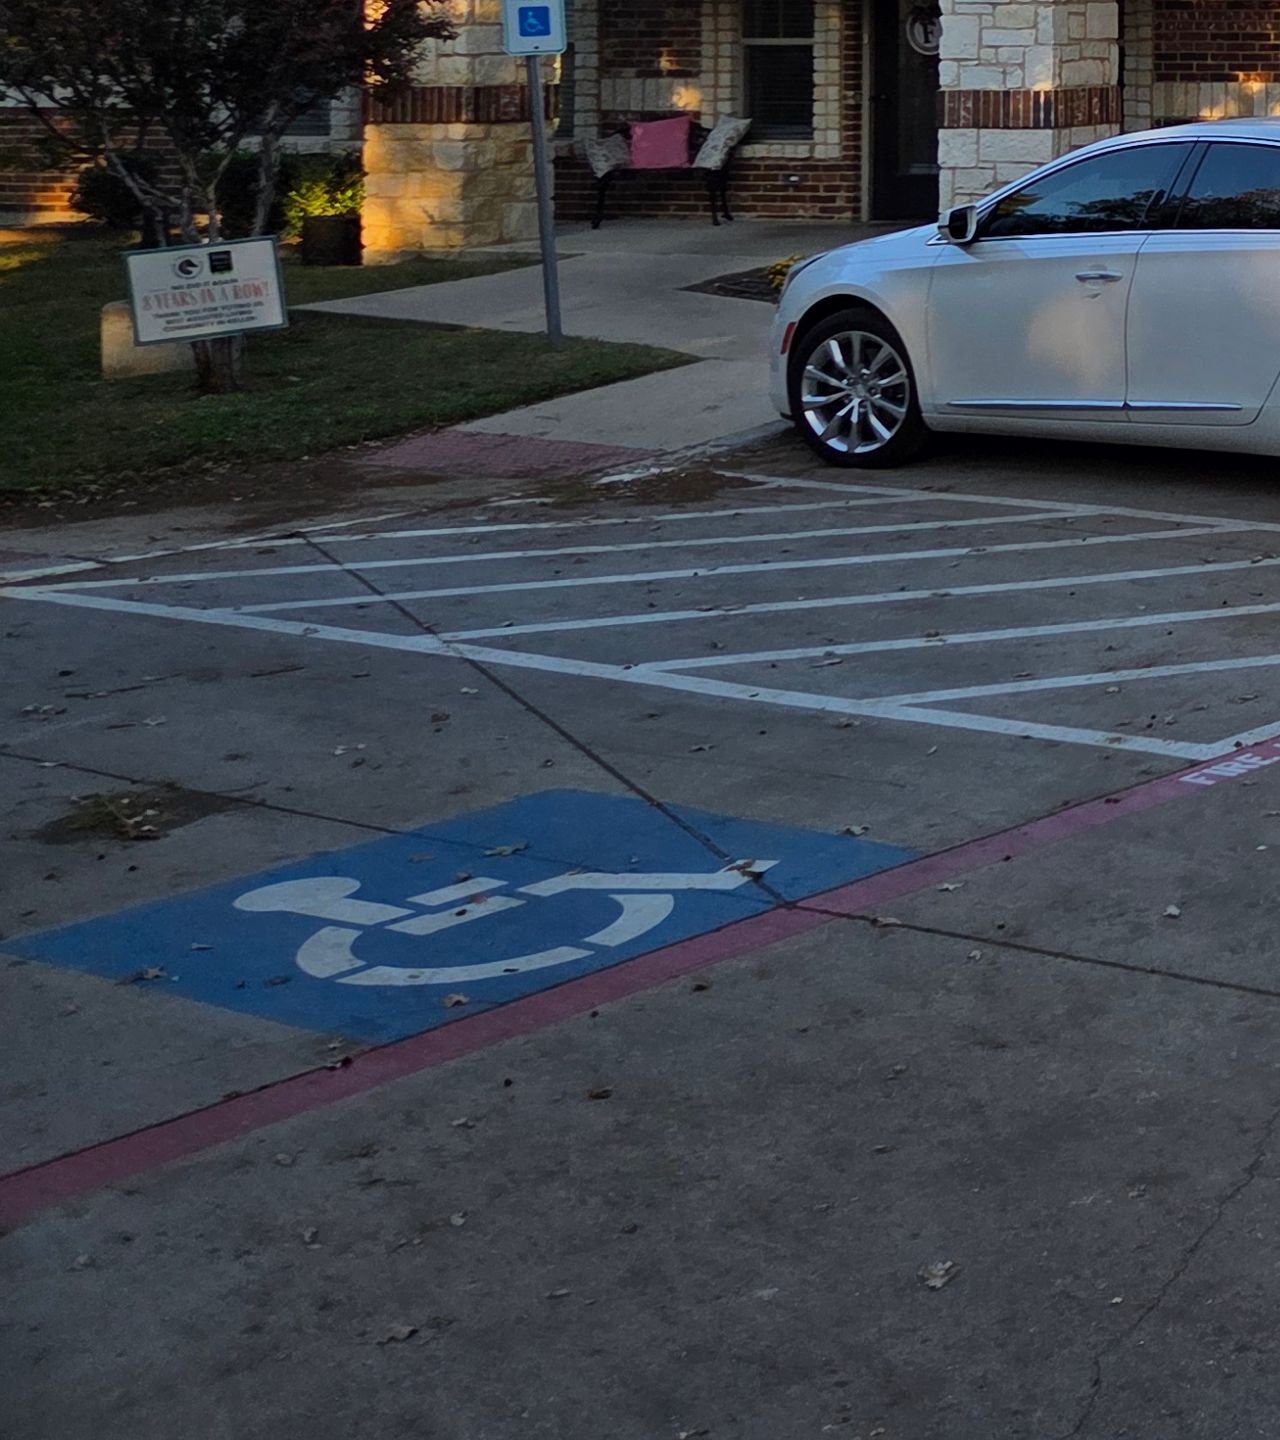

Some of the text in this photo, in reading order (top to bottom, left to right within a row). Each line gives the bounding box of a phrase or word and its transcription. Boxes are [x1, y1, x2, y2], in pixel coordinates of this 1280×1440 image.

[920, 21, 937, 44] F
[142, 294, 153, 311] 8
[154, 290, 198, 309] YEARS
[200, 287, 216, 304] IN
[219, 286, 229, 302] A
